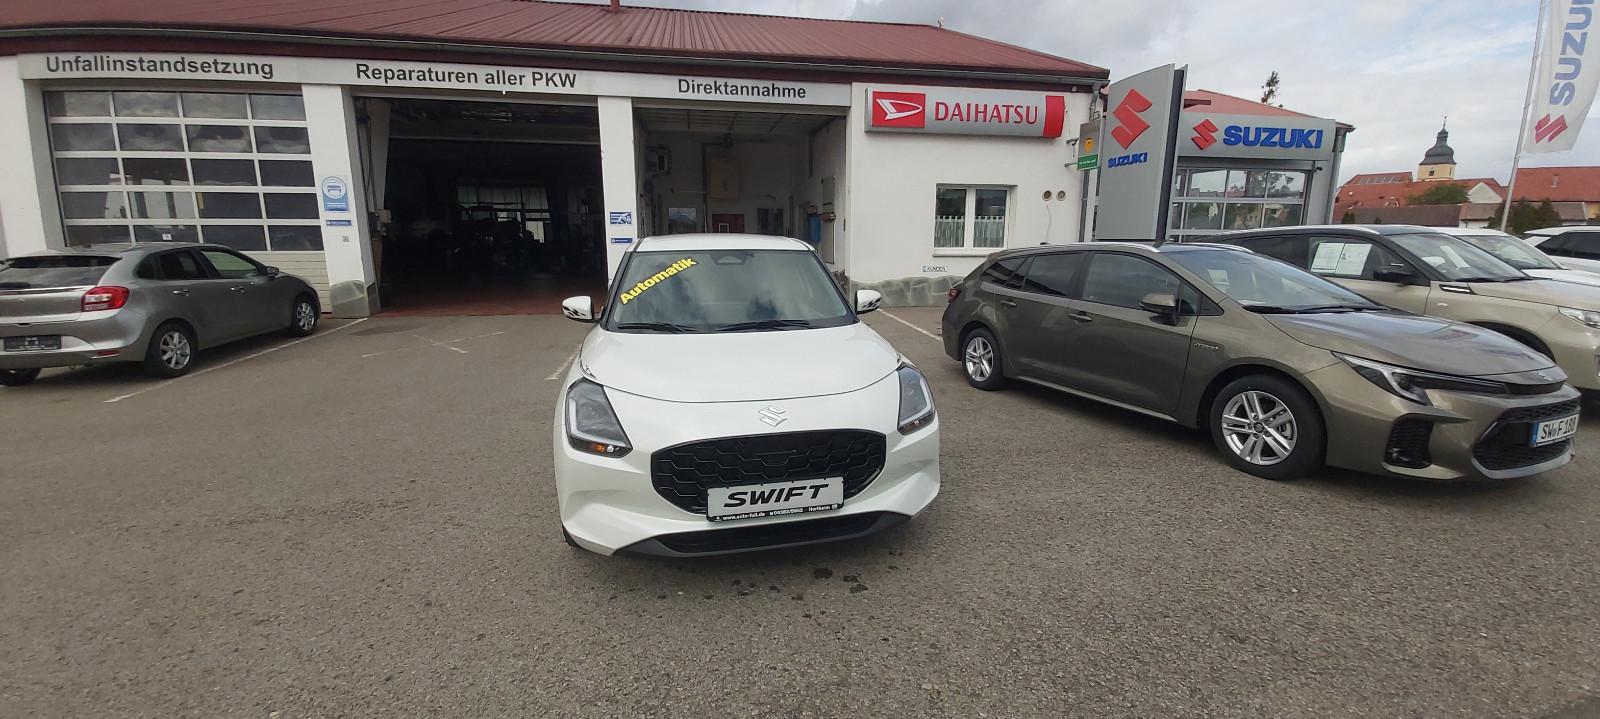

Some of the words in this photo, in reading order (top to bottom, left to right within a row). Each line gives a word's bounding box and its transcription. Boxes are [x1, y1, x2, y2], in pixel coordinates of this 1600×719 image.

[1549, 0, 1595, 106] SUZU
[46, 56, 274, 80] Unfallinstandsetzung
[355, 63, 479, 86] Reparaturen
[484, 69, 526, 87] aller
[531, 72, 577, 89] PKW
[677, 78, 807, 99] Direktannahme
[934, 101, 1039, 125] DAIHATSU
[1223, 125, 1324, 149] SUZUKI
[1107, 152, 1148, 168] SUZUKI
[619, 257, 698, 305] Automatik
[723, 483, 830, 508] SWIFT
